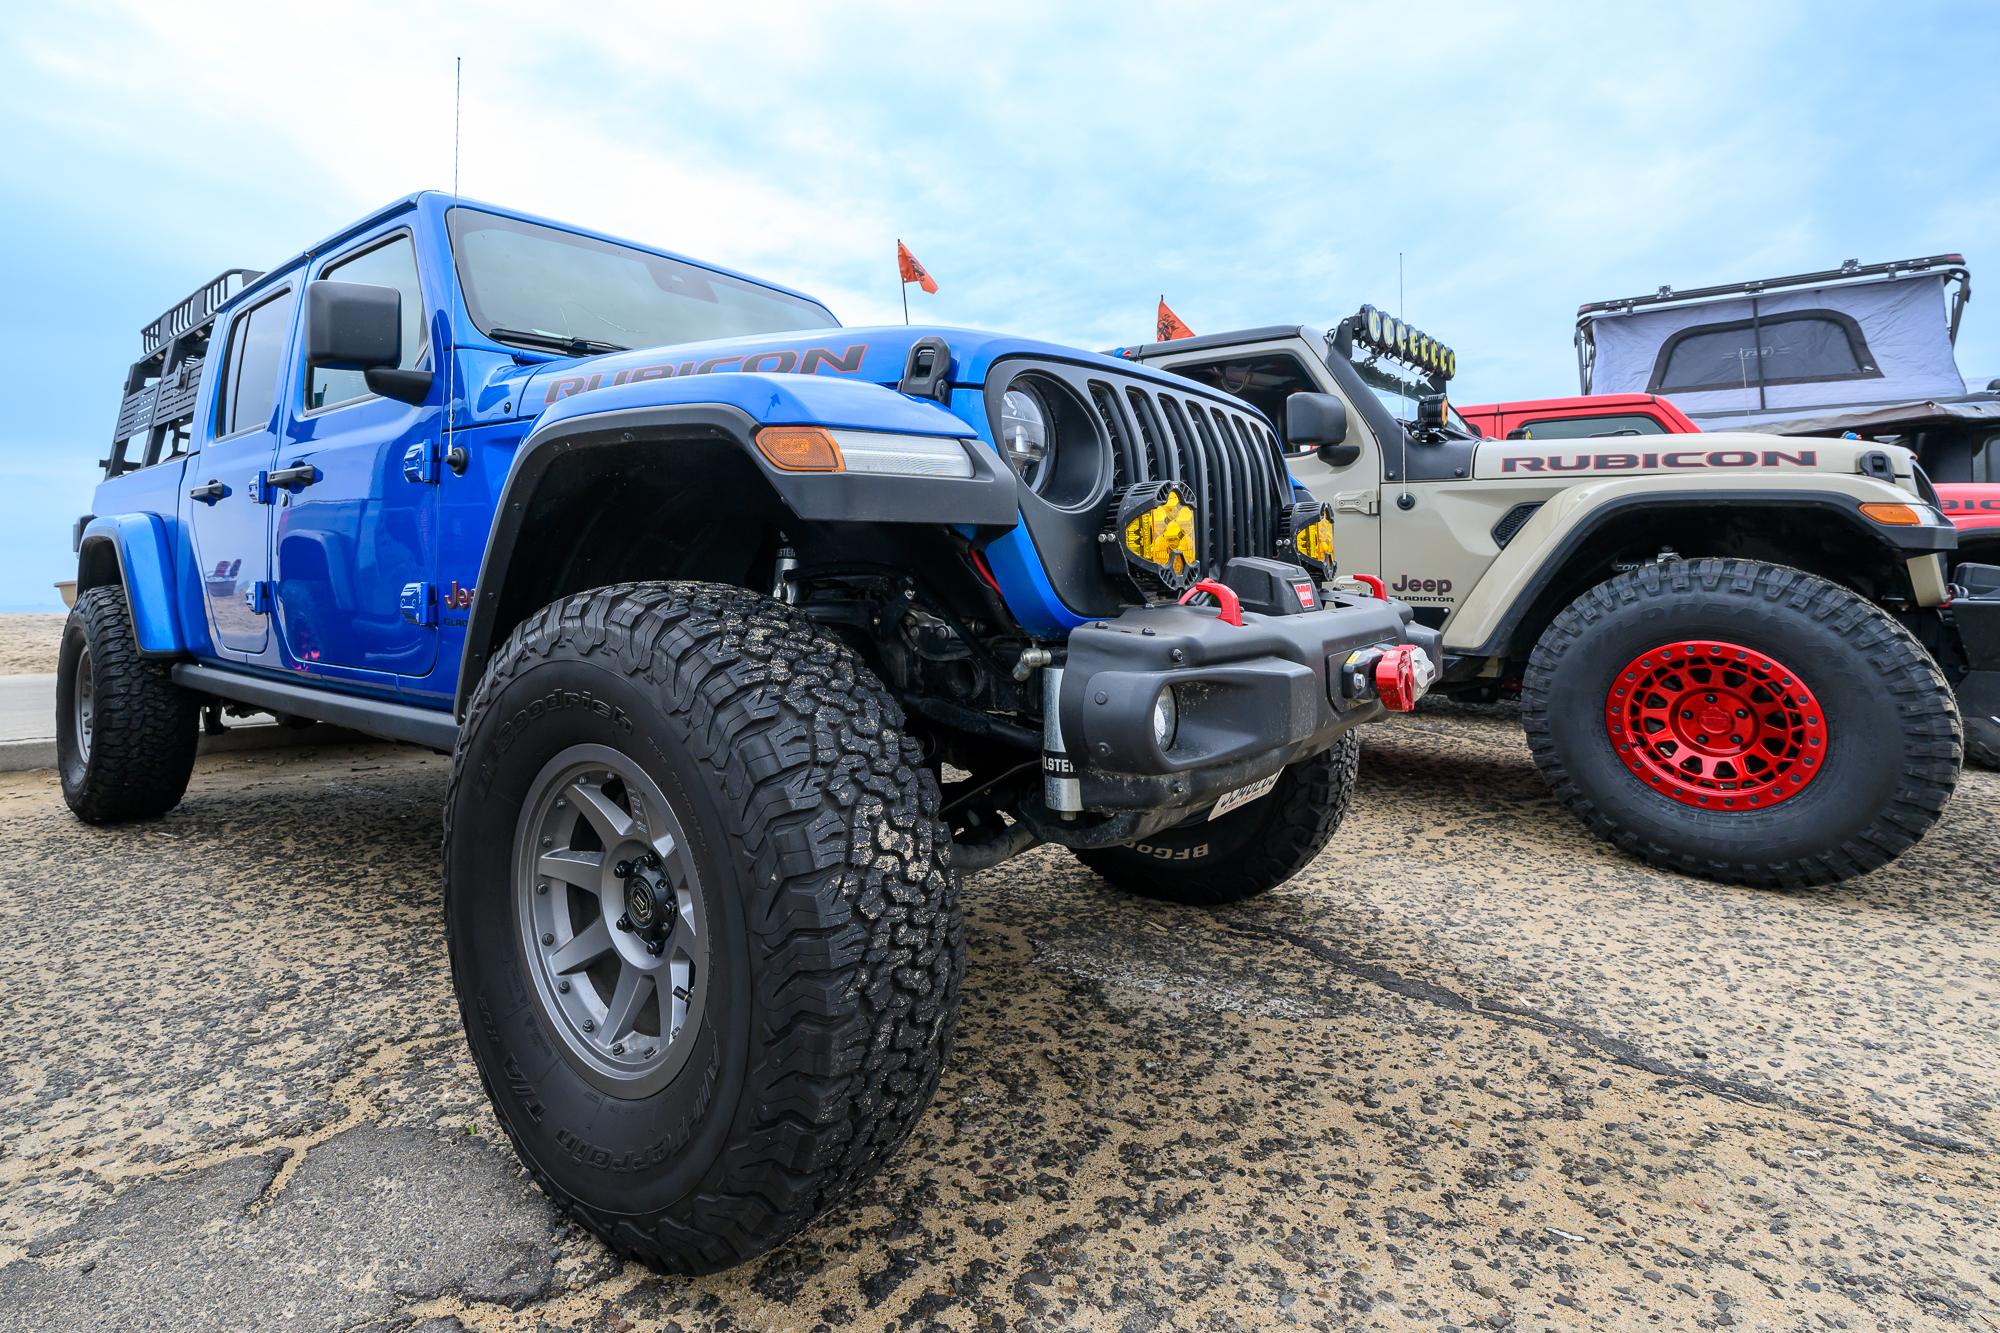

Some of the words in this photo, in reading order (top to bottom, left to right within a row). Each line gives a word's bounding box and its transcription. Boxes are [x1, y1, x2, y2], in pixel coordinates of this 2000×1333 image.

[1501, 450, 1817, 473] RUBICON
[444, 580, 475, 609] Je
[1392, 574, 1452, 596] Jeep
